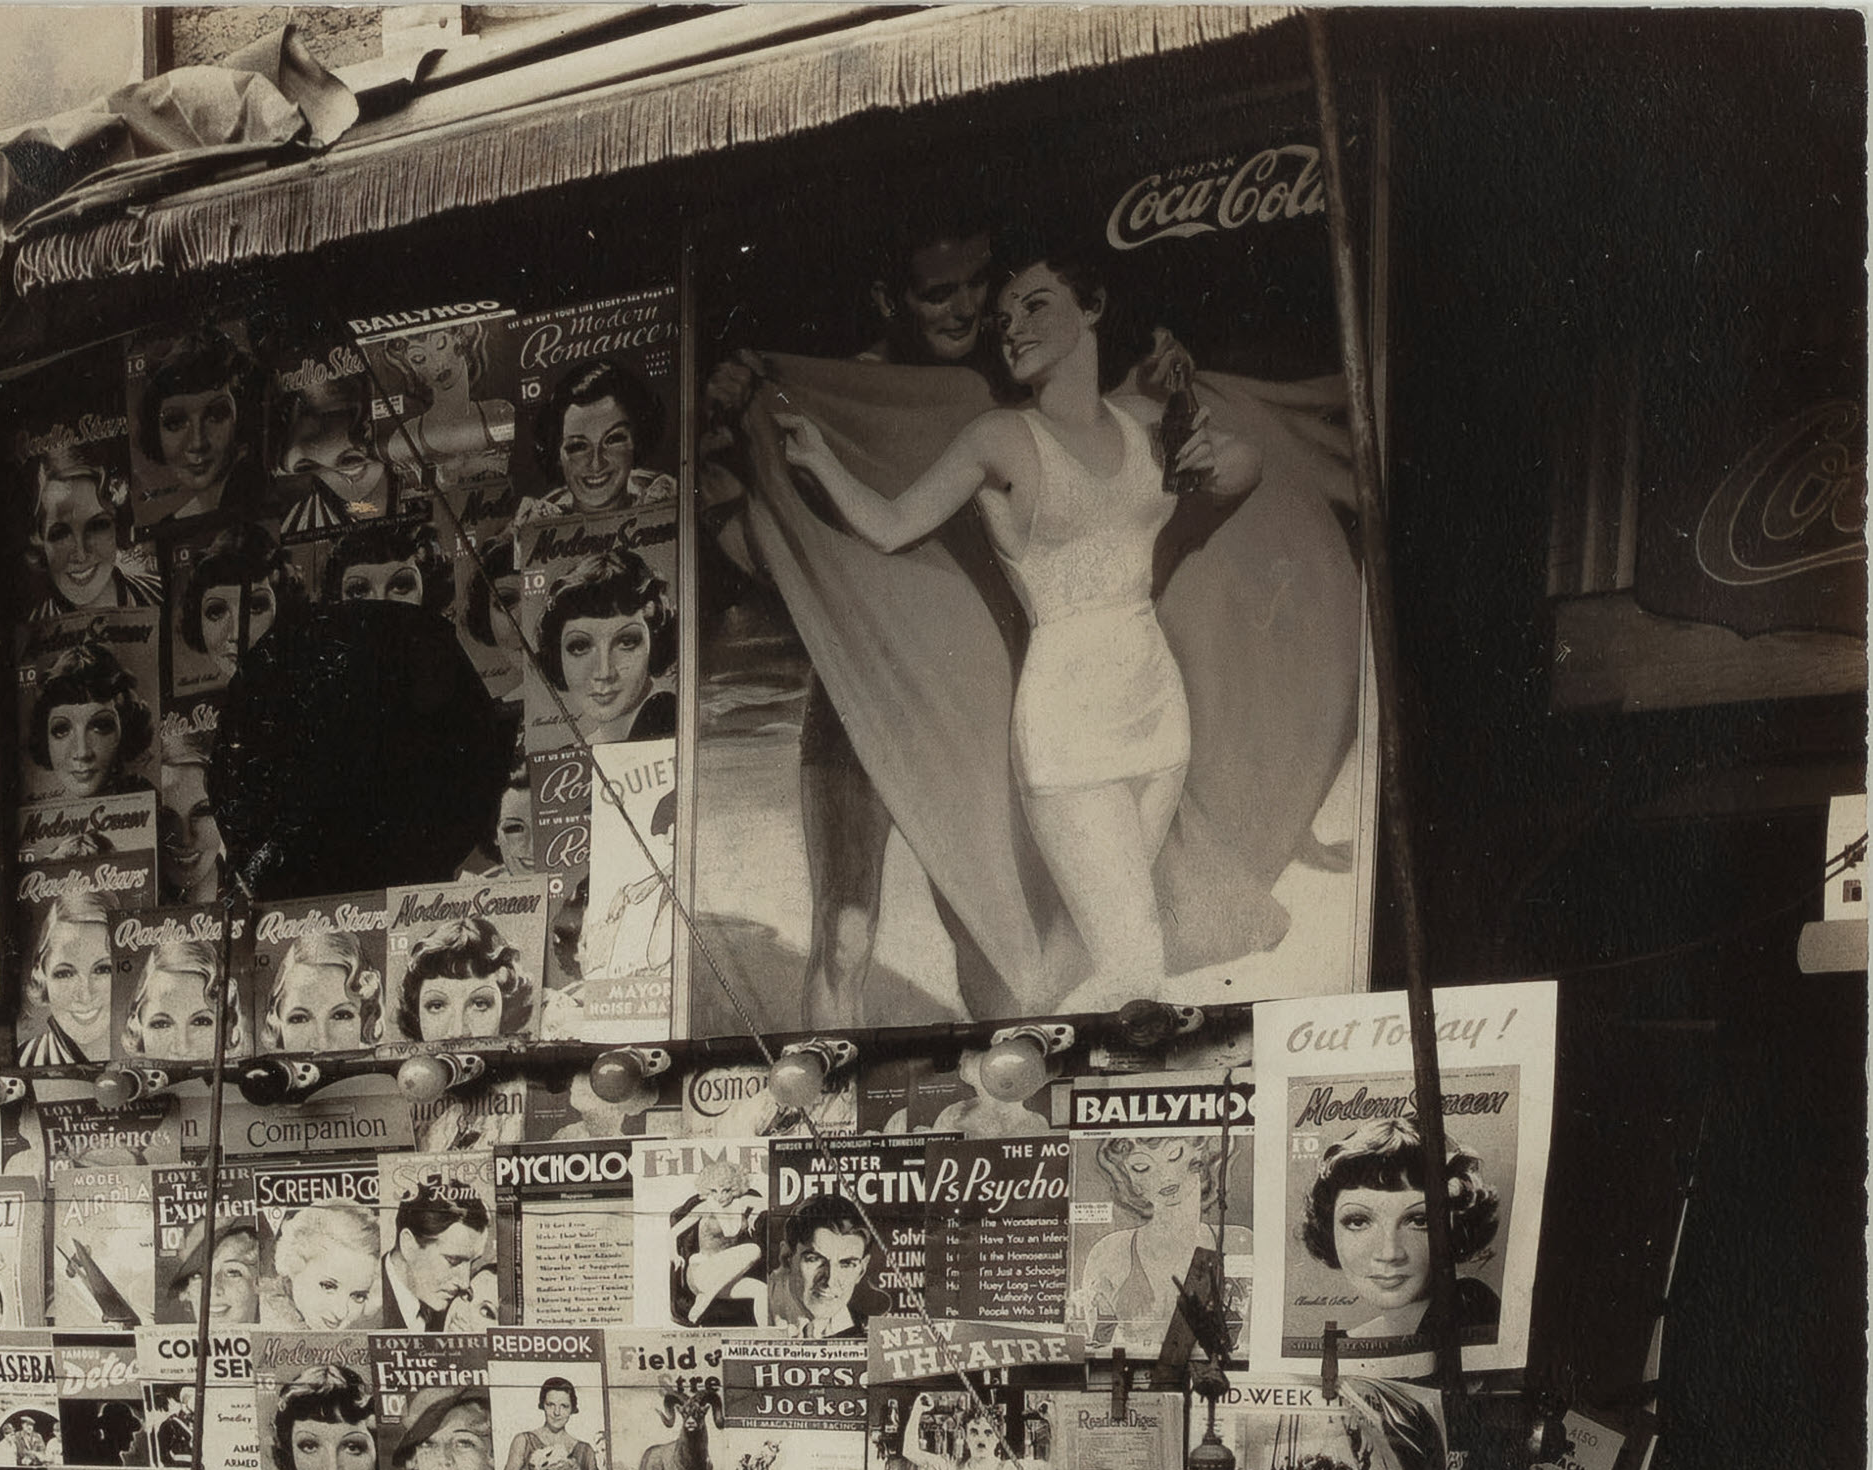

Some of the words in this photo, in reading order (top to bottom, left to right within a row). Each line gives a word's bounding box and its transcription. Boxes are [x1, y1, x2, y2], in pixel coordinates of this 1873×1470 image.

[1162, 154, 1239, 181] DRINK
[348, 299, 501, 335] BALLYHOO
[256, 908, 326, 943] Radio
[326, 900, 389, 934] Stars
[392, 893, 470, 928] Modern
[471, 888, 543, 920] Screen
[1285, 1018, 1362, 1055] Out
[1370, 1008, 1517, 1053] Toay!
[1076, 1093, 1255, 1123] BALLYHO
[1296, 1084, 1403, 1128] Modern
[1409, 1087, 1509, 1120] Sreen
[246, 1116, 388, 1149] Companion
[811, 1157, 881, 1173] MASTER
[260, 1174, 338, 1203] SCREEN
[493, 1334, 592, 1354] REDBOOK
[880, 1322, 954, 1355] NEW
[884, 1335, 1071, 1381] THEATRE
